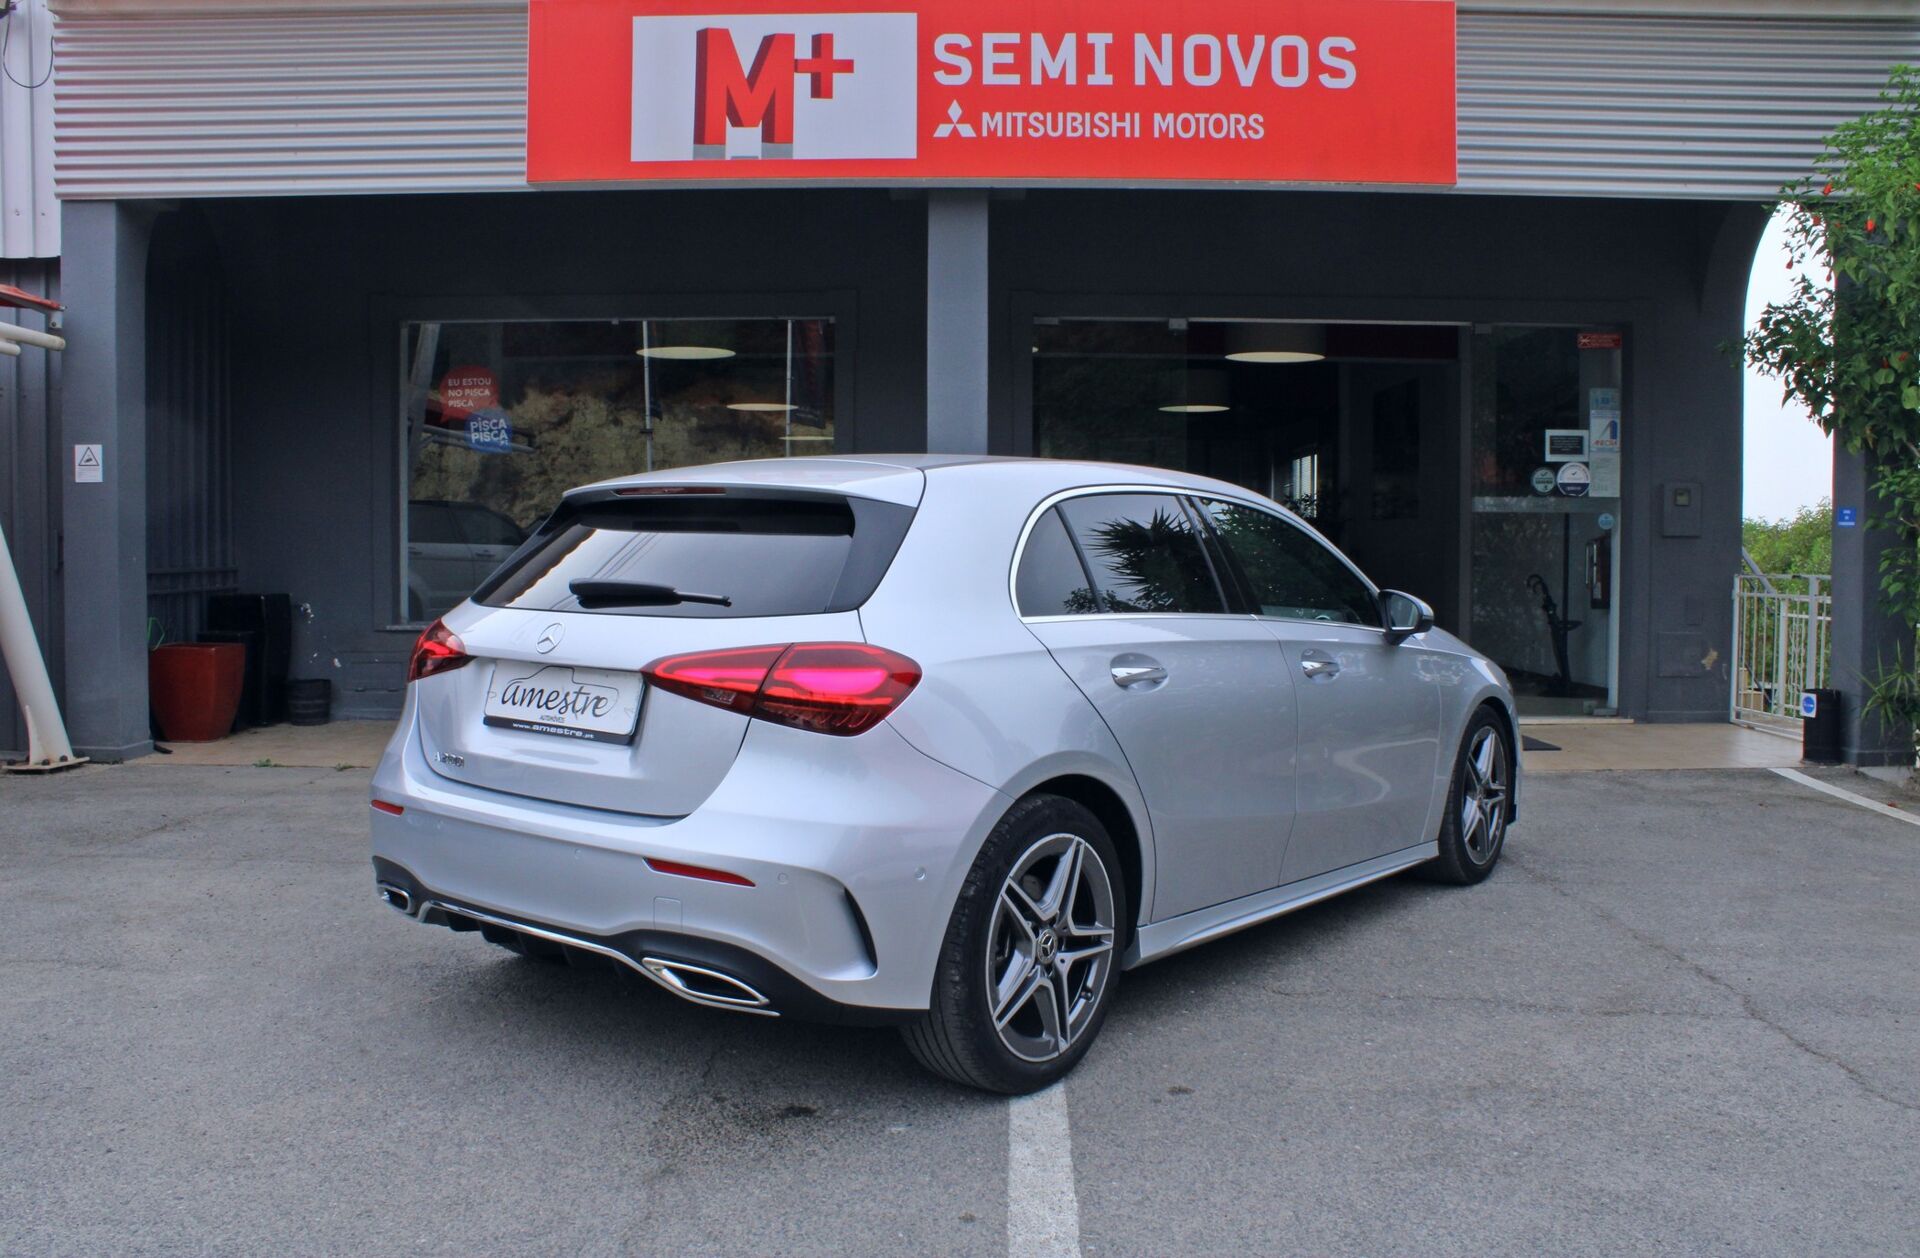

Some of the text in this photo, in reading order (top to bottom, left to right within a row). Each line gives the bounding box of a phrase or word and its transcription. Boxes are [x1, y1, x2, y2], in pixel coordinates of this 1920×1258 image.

[933, 32, 1357, 89] SEMI NOVOS
[981, 111, 1265, 139] MITSUBISHI MOTORS
[448, 377, 492, 387] EU ESTOU
[448, 388, 491, 398] NO PISCA
[448, 399, 474, 408] PISCA
[501, 681, 609, 719] amestre
[512, 721, 595, 739] www.amestre.pt
